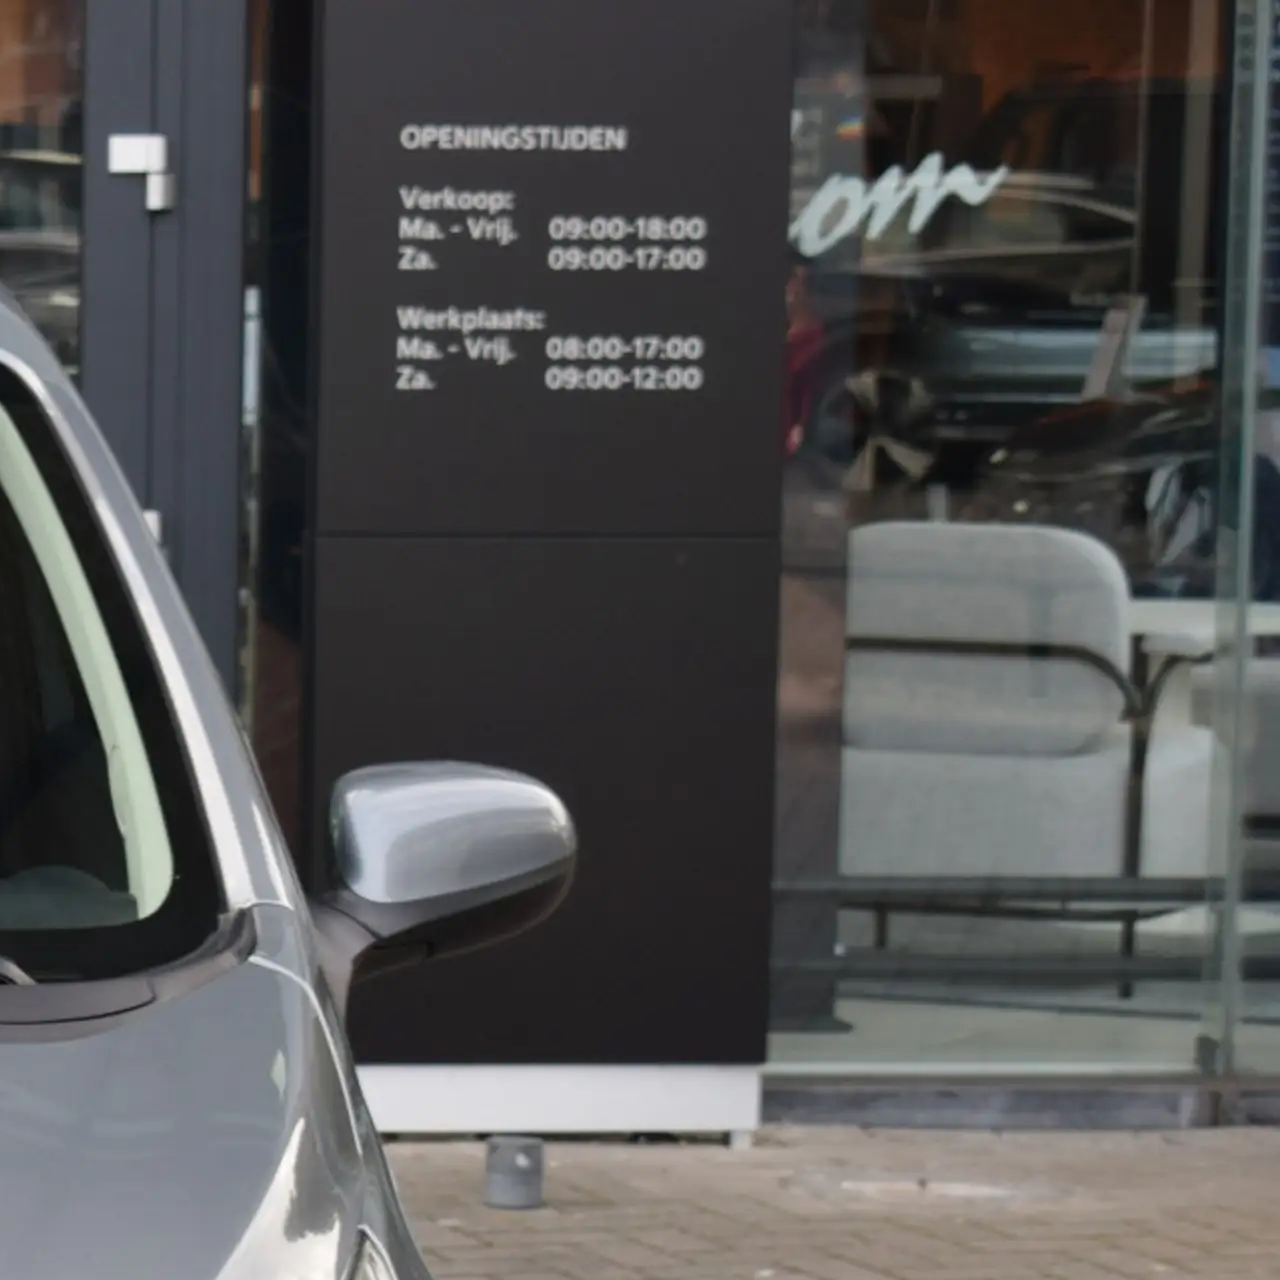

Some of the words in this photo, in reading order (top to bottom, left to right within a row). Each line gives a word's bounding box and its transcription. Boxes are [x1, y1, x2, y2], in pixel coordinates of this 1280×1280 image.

[400, 124, 628, 150] OPENINGSTIJDEN
[398, 186, 516, 215] Verkoop:
[398, 216, 444, 240] Ma.
[466, 217, 519, 247] Vrij.
[547, 216, 708, 241] 09:00-18:00
[397, 246, 439, 270] Za.
[547, 246, 708, 271] 09:00-17:00
[396, 306, 547, 335] Werkplaats:
[396, 337, 443, 360] Ma.
[463, 336, 517, 366] Vrij.
[545, 335, 705, 360] 08:00-17:00
[395, 365, 437, 390] Za.
[544, 366, 704, 390] 09:00-12:00
